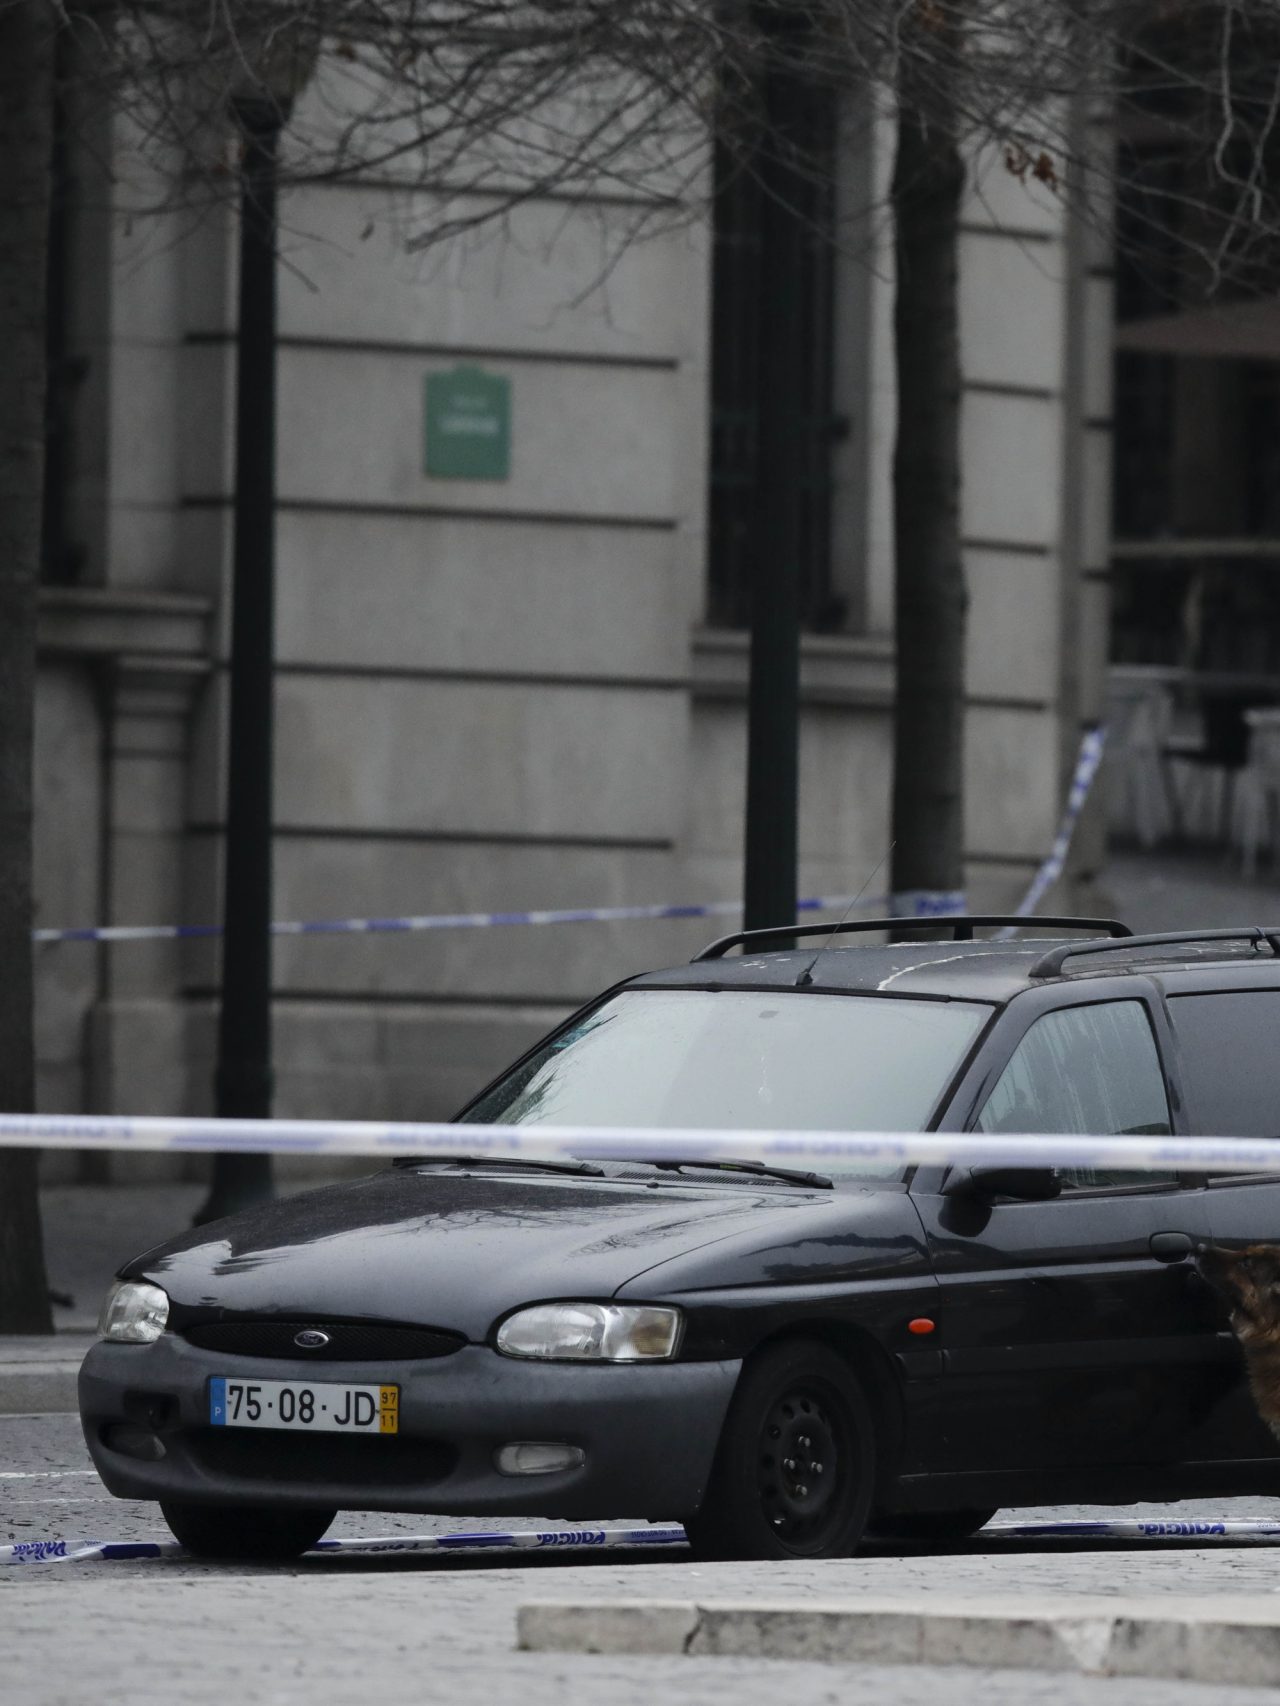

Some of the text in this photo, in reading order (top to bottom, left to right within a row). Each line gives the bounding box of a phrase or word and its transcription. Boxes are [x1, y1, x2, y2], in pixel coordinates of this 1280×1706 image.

[381, 1392, 397, 1405] 97
[214, 1407, 222, 1417] P
[381, 1414, 396, 1428] 11
